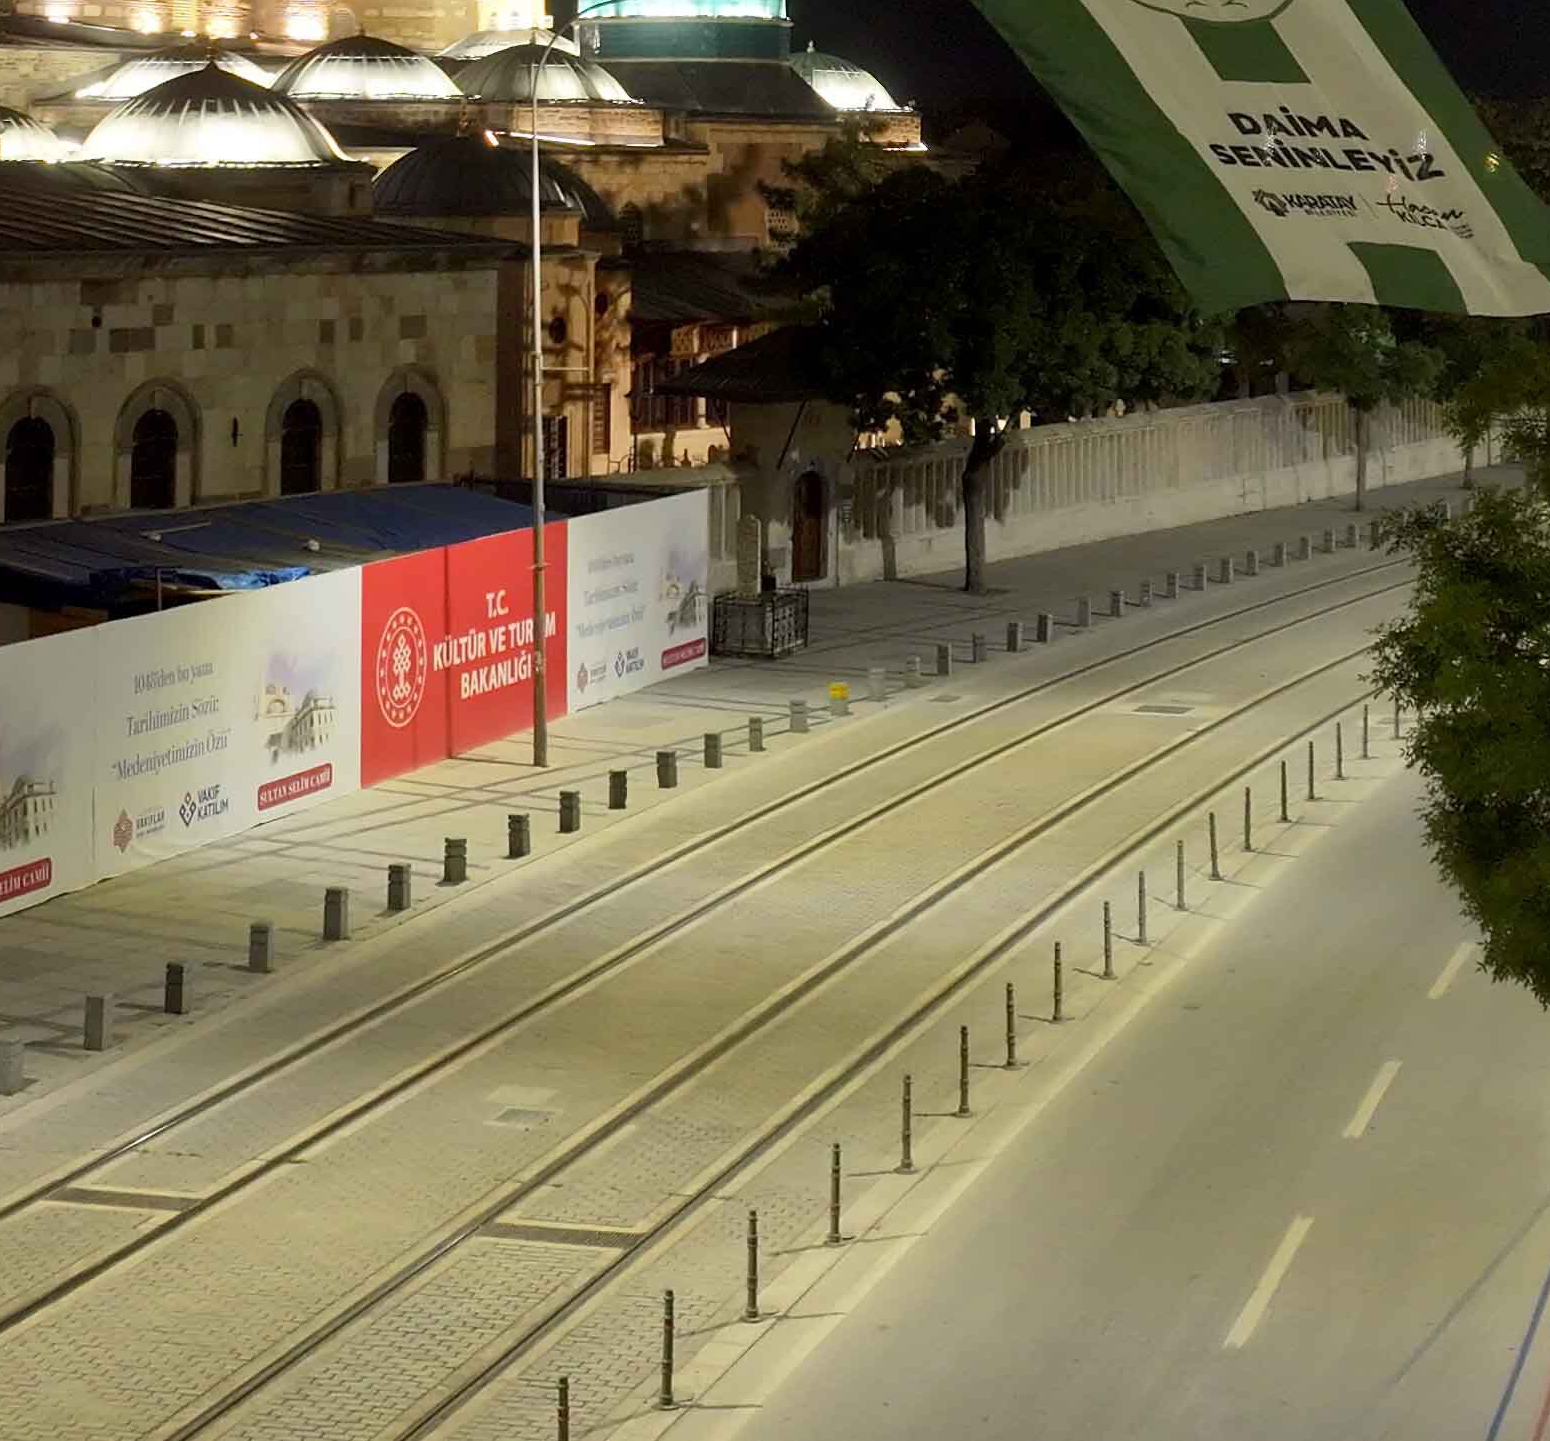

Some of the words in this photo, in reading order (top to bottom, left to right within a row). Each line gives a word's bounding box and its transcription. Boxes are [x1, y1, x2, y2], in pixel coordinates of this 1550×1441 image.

[1227, 106, 1369, 141] DAİMA
[1209, 139, 1446, 182] SENİNLEYİZ
[1282, 193, 1358, 211] KARATAY
[433, 628, 486, 671] KÜLTÜR
[489, 626, 506, 654] VE
[508, 611, 556, 648] TURM
[461, 649, 532, 699] BAKANLIĞI
